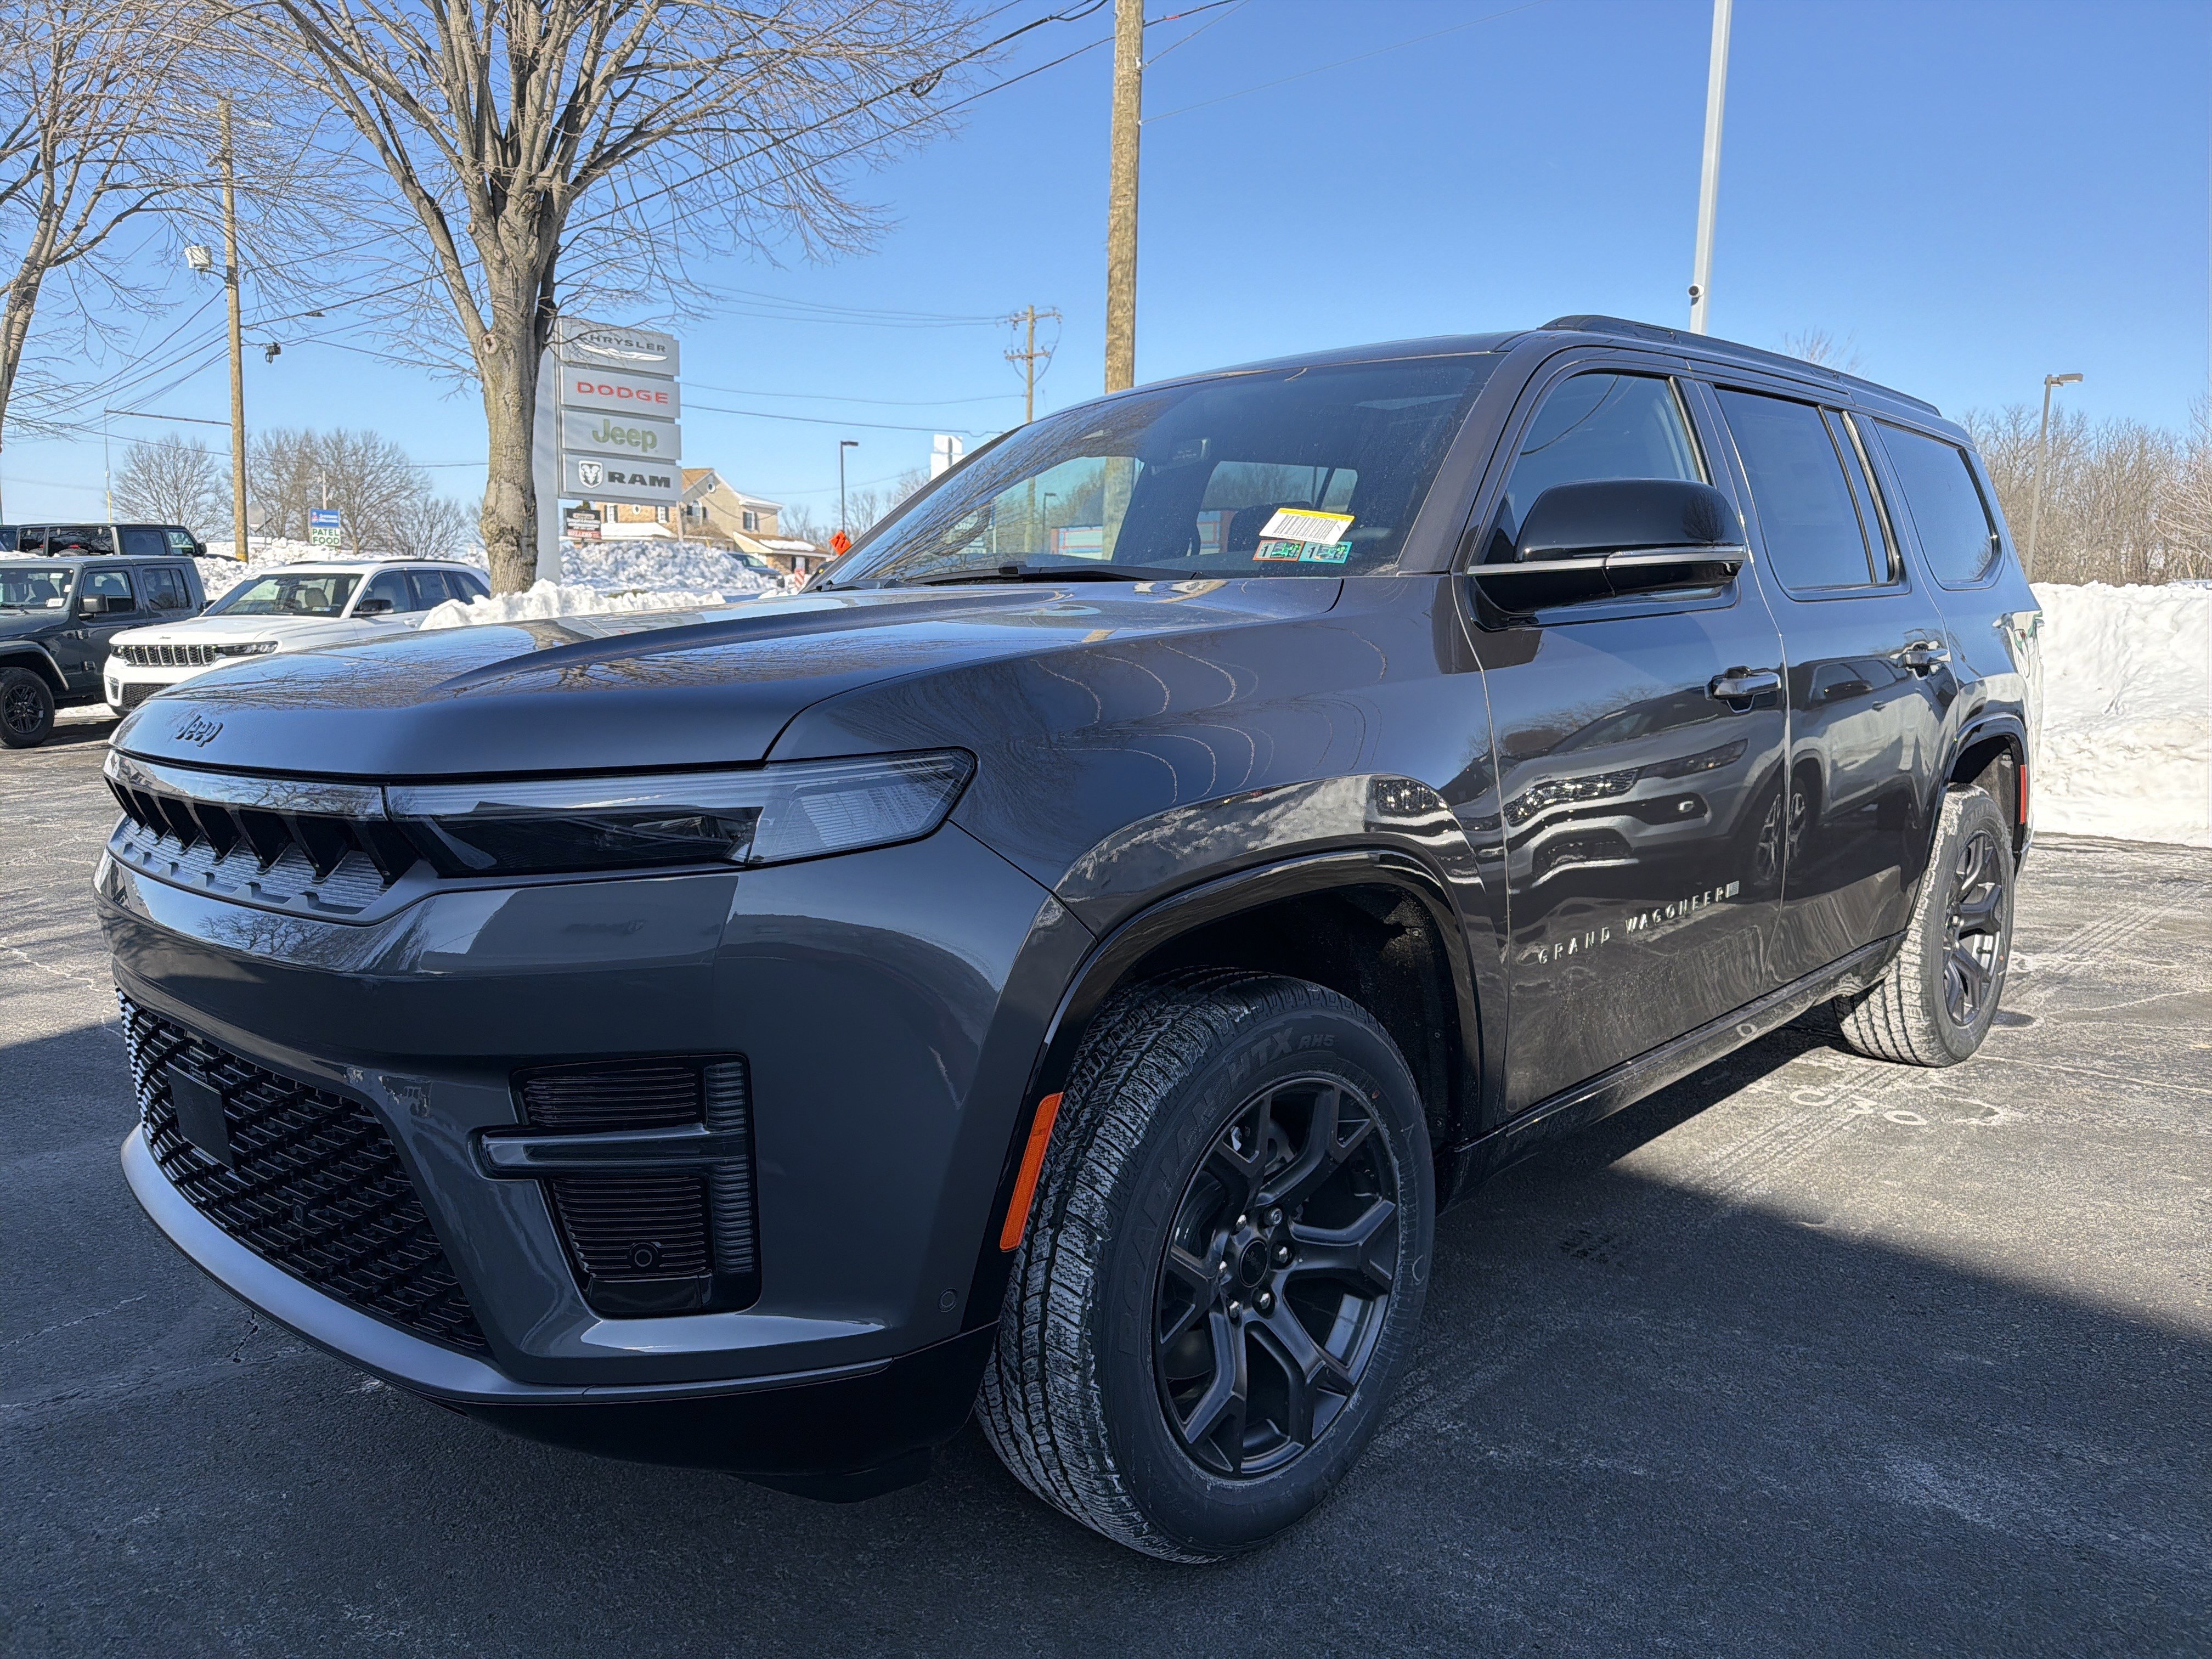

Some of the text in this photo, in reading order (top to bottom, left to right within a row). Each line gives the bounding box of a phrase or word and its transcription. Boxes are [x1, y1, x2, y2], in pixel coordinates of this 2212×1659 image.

[579, 333, 666, 352] HRYSLER
[577, 381, 669, 404] DODGE
[592, 419, 658, 453] Jeep
[608, 471, 671, 488] RAM
[175, 714, 224, 748] Jeep
[1538, 887, 1723, 964] GRAND WAGONEER
[1228, 1027, 1294, 1090] HTX
